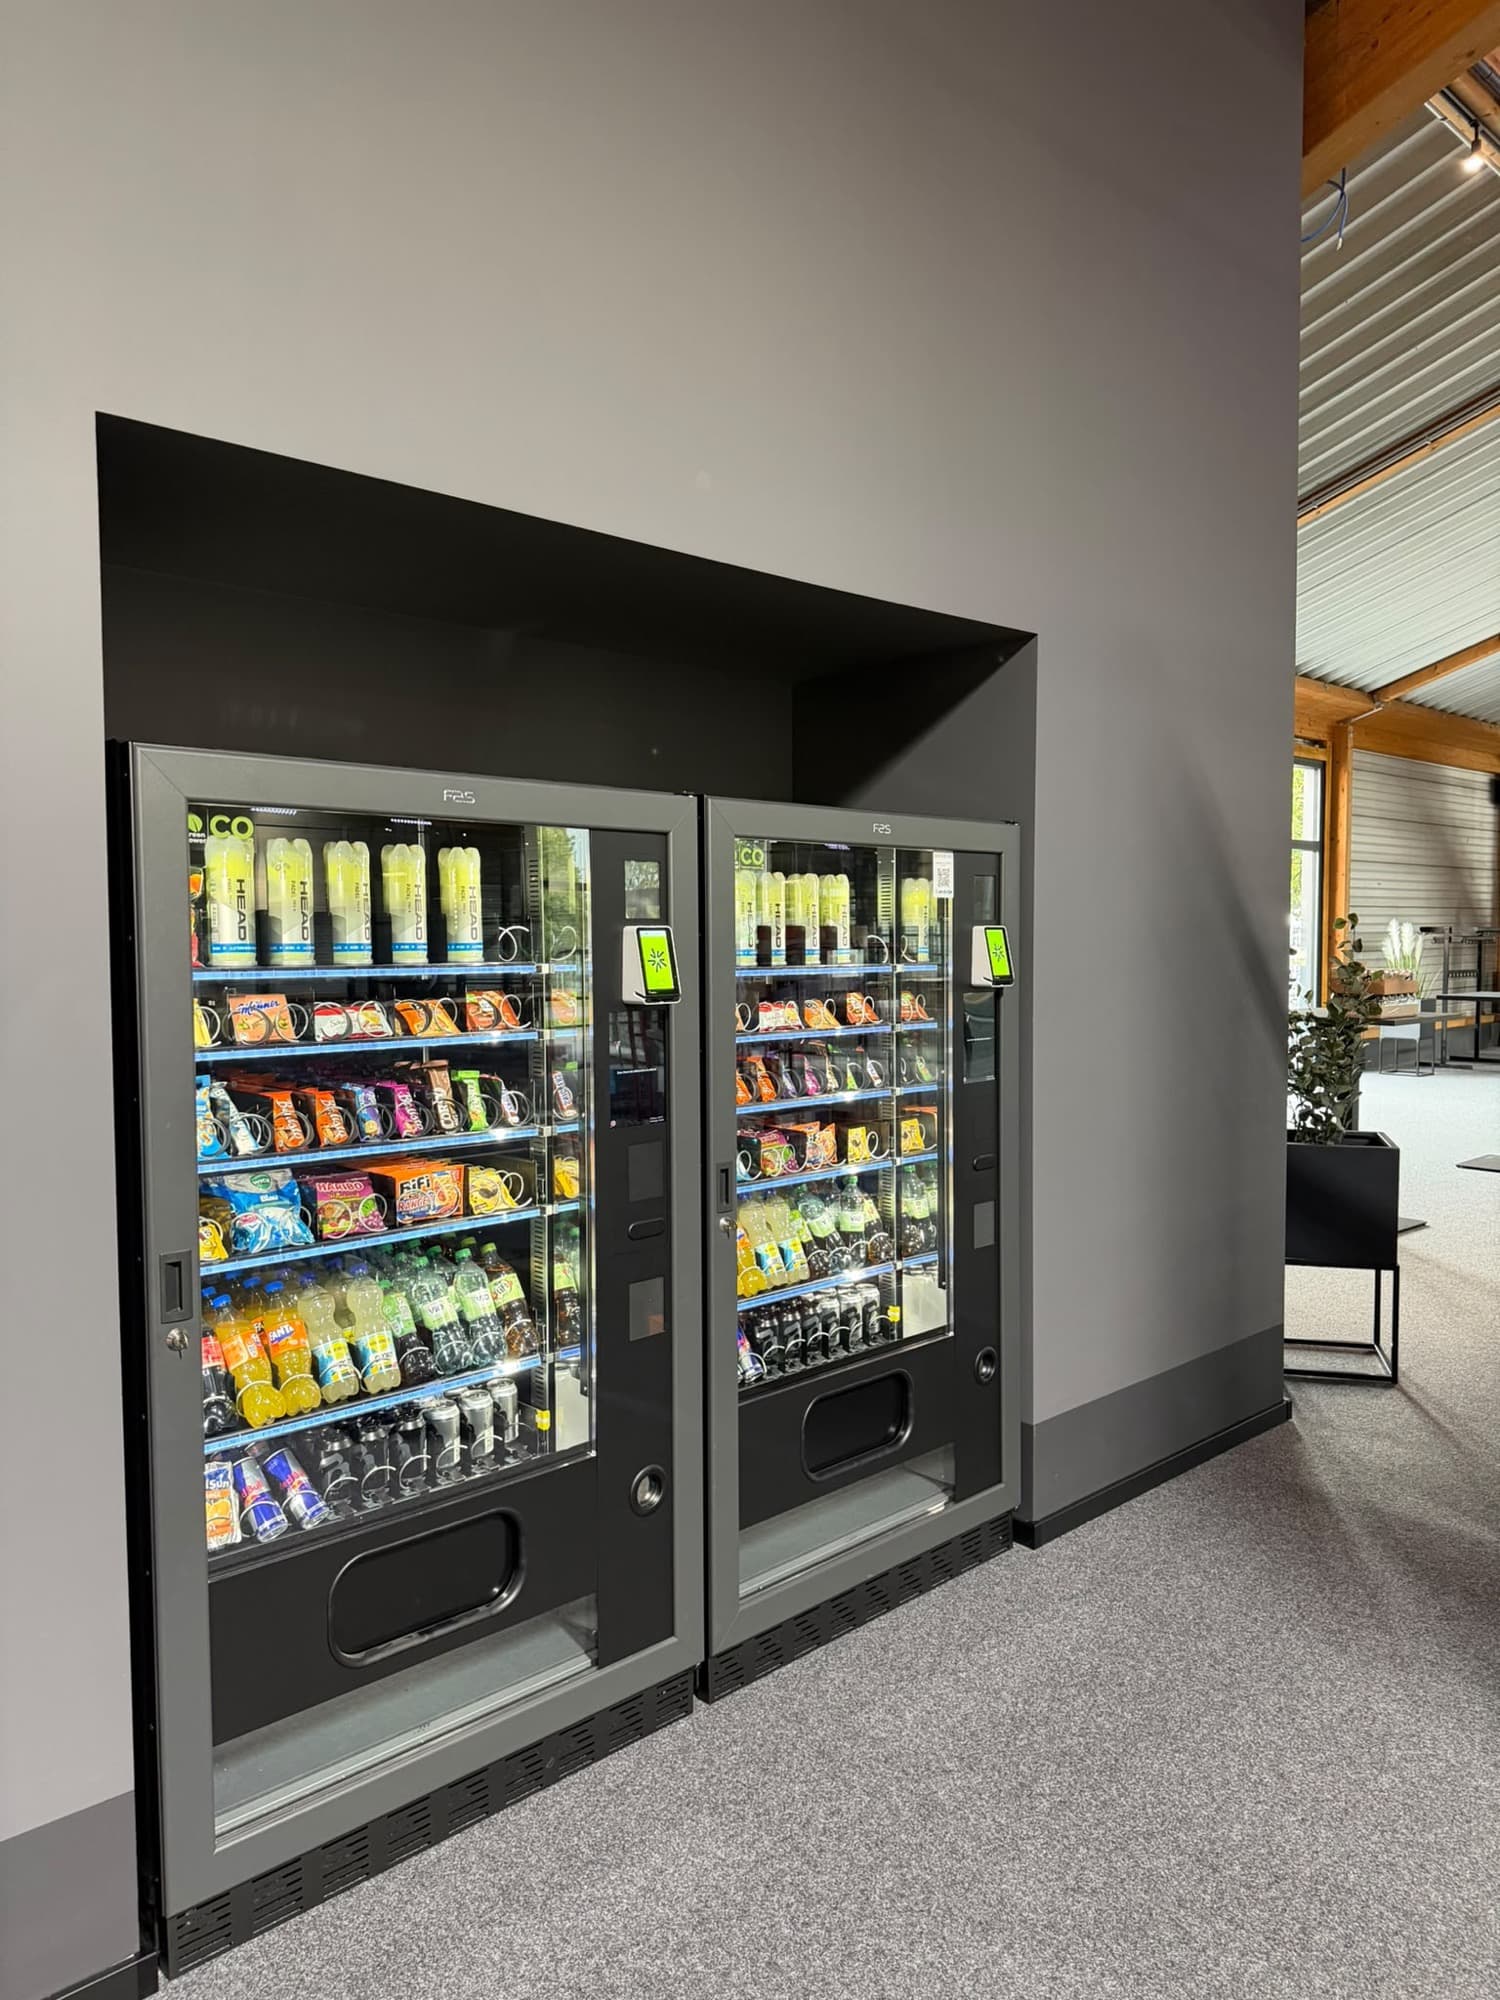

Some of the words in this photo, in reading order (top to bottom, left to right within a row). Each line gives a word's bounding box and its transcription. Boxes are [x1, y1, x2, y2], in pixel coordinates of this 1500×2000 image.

[236, 879, 248, 941] HEAD
[300, 881, 310, 941] HEAD
[362, 882, 371, 941] HEAD
[414, 884, 423, 941] HEAD
[469, 886, 478, 941] HEAD
[315, 1181, 364, 1193] HARIBO
